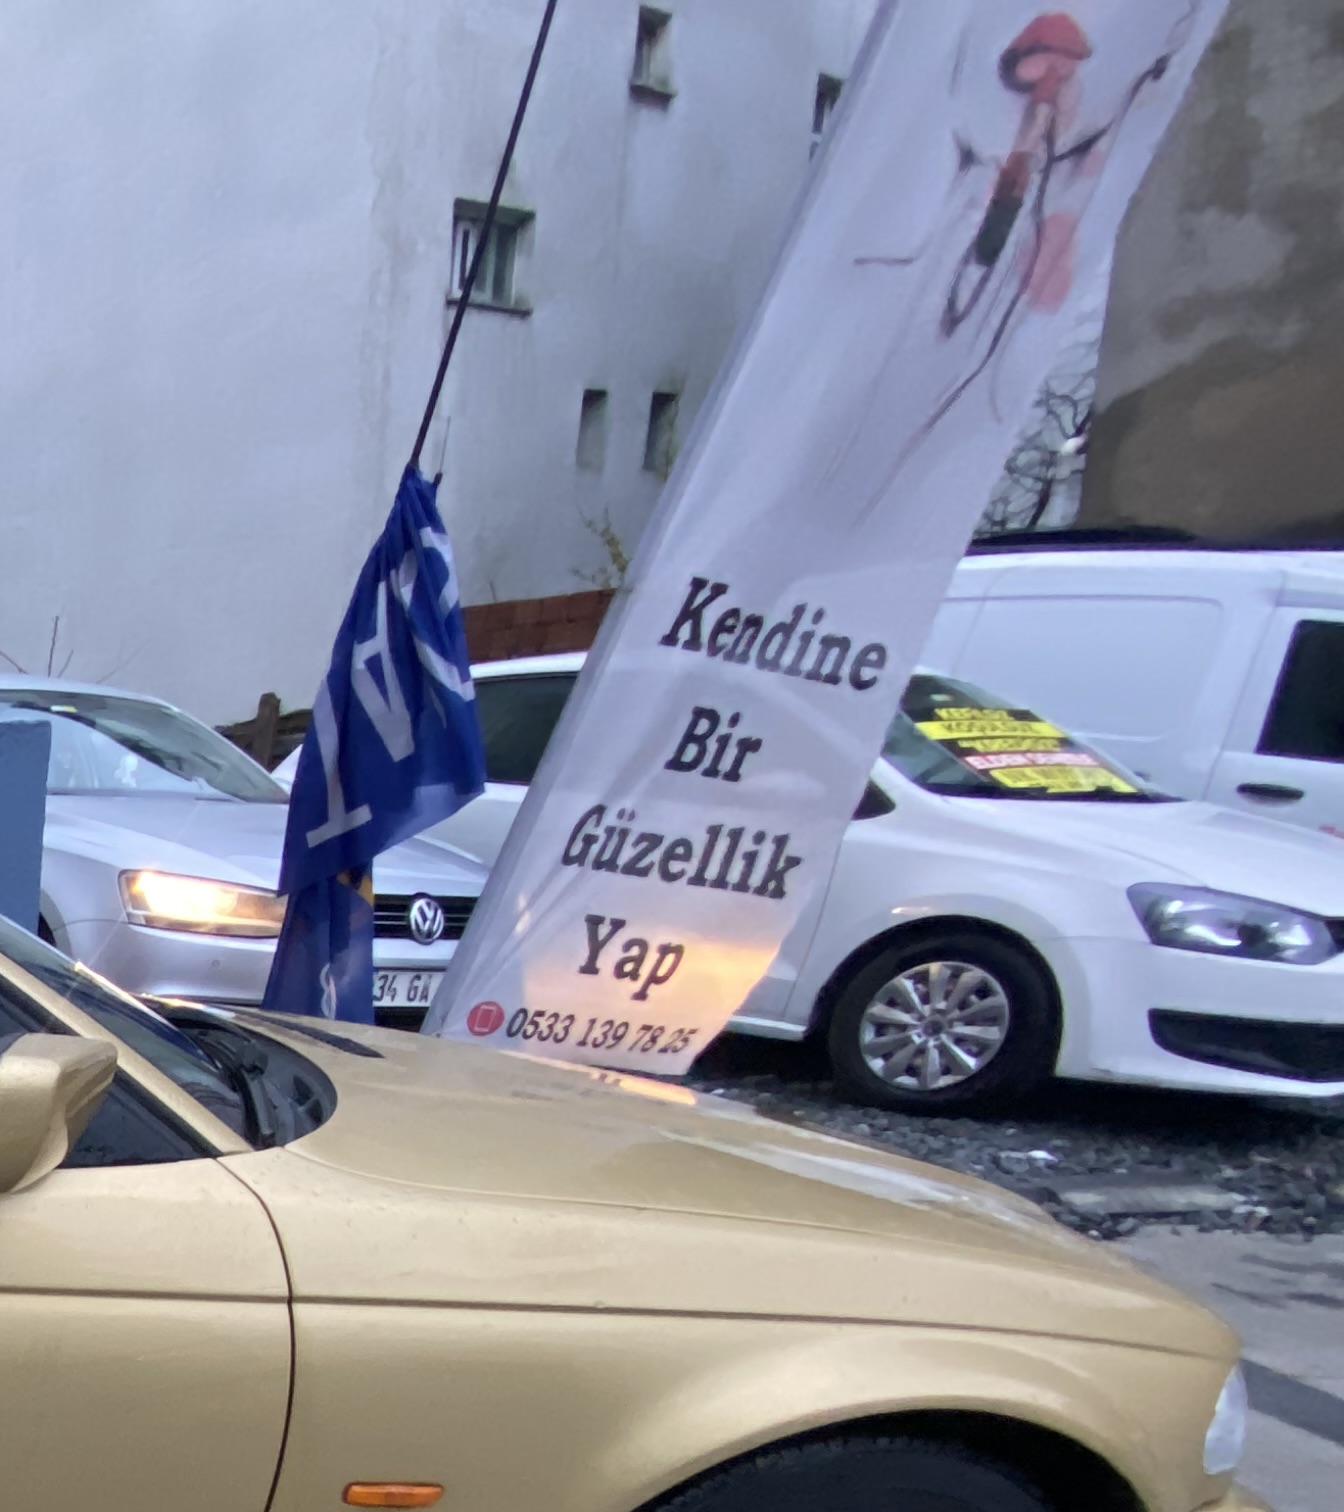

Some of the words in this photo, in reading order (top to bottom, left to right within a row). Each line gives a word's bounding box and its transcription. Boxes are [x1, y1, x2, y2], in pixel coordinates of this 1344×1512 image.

[658, 577, 888, 691] Kendine
[664, 706, 763, 782] Bir
[561, 803, 803, 899] Güzellik
[373, 974, 397, 1002] 34
[578, 914, 685, 1001] Yap
[506, 1007, 575, 1045] 0533
[576, 1018, 629, 1050] 139
[628, 1024, 665, 1052] 78
[664, 1028, 700, 1053] 25
